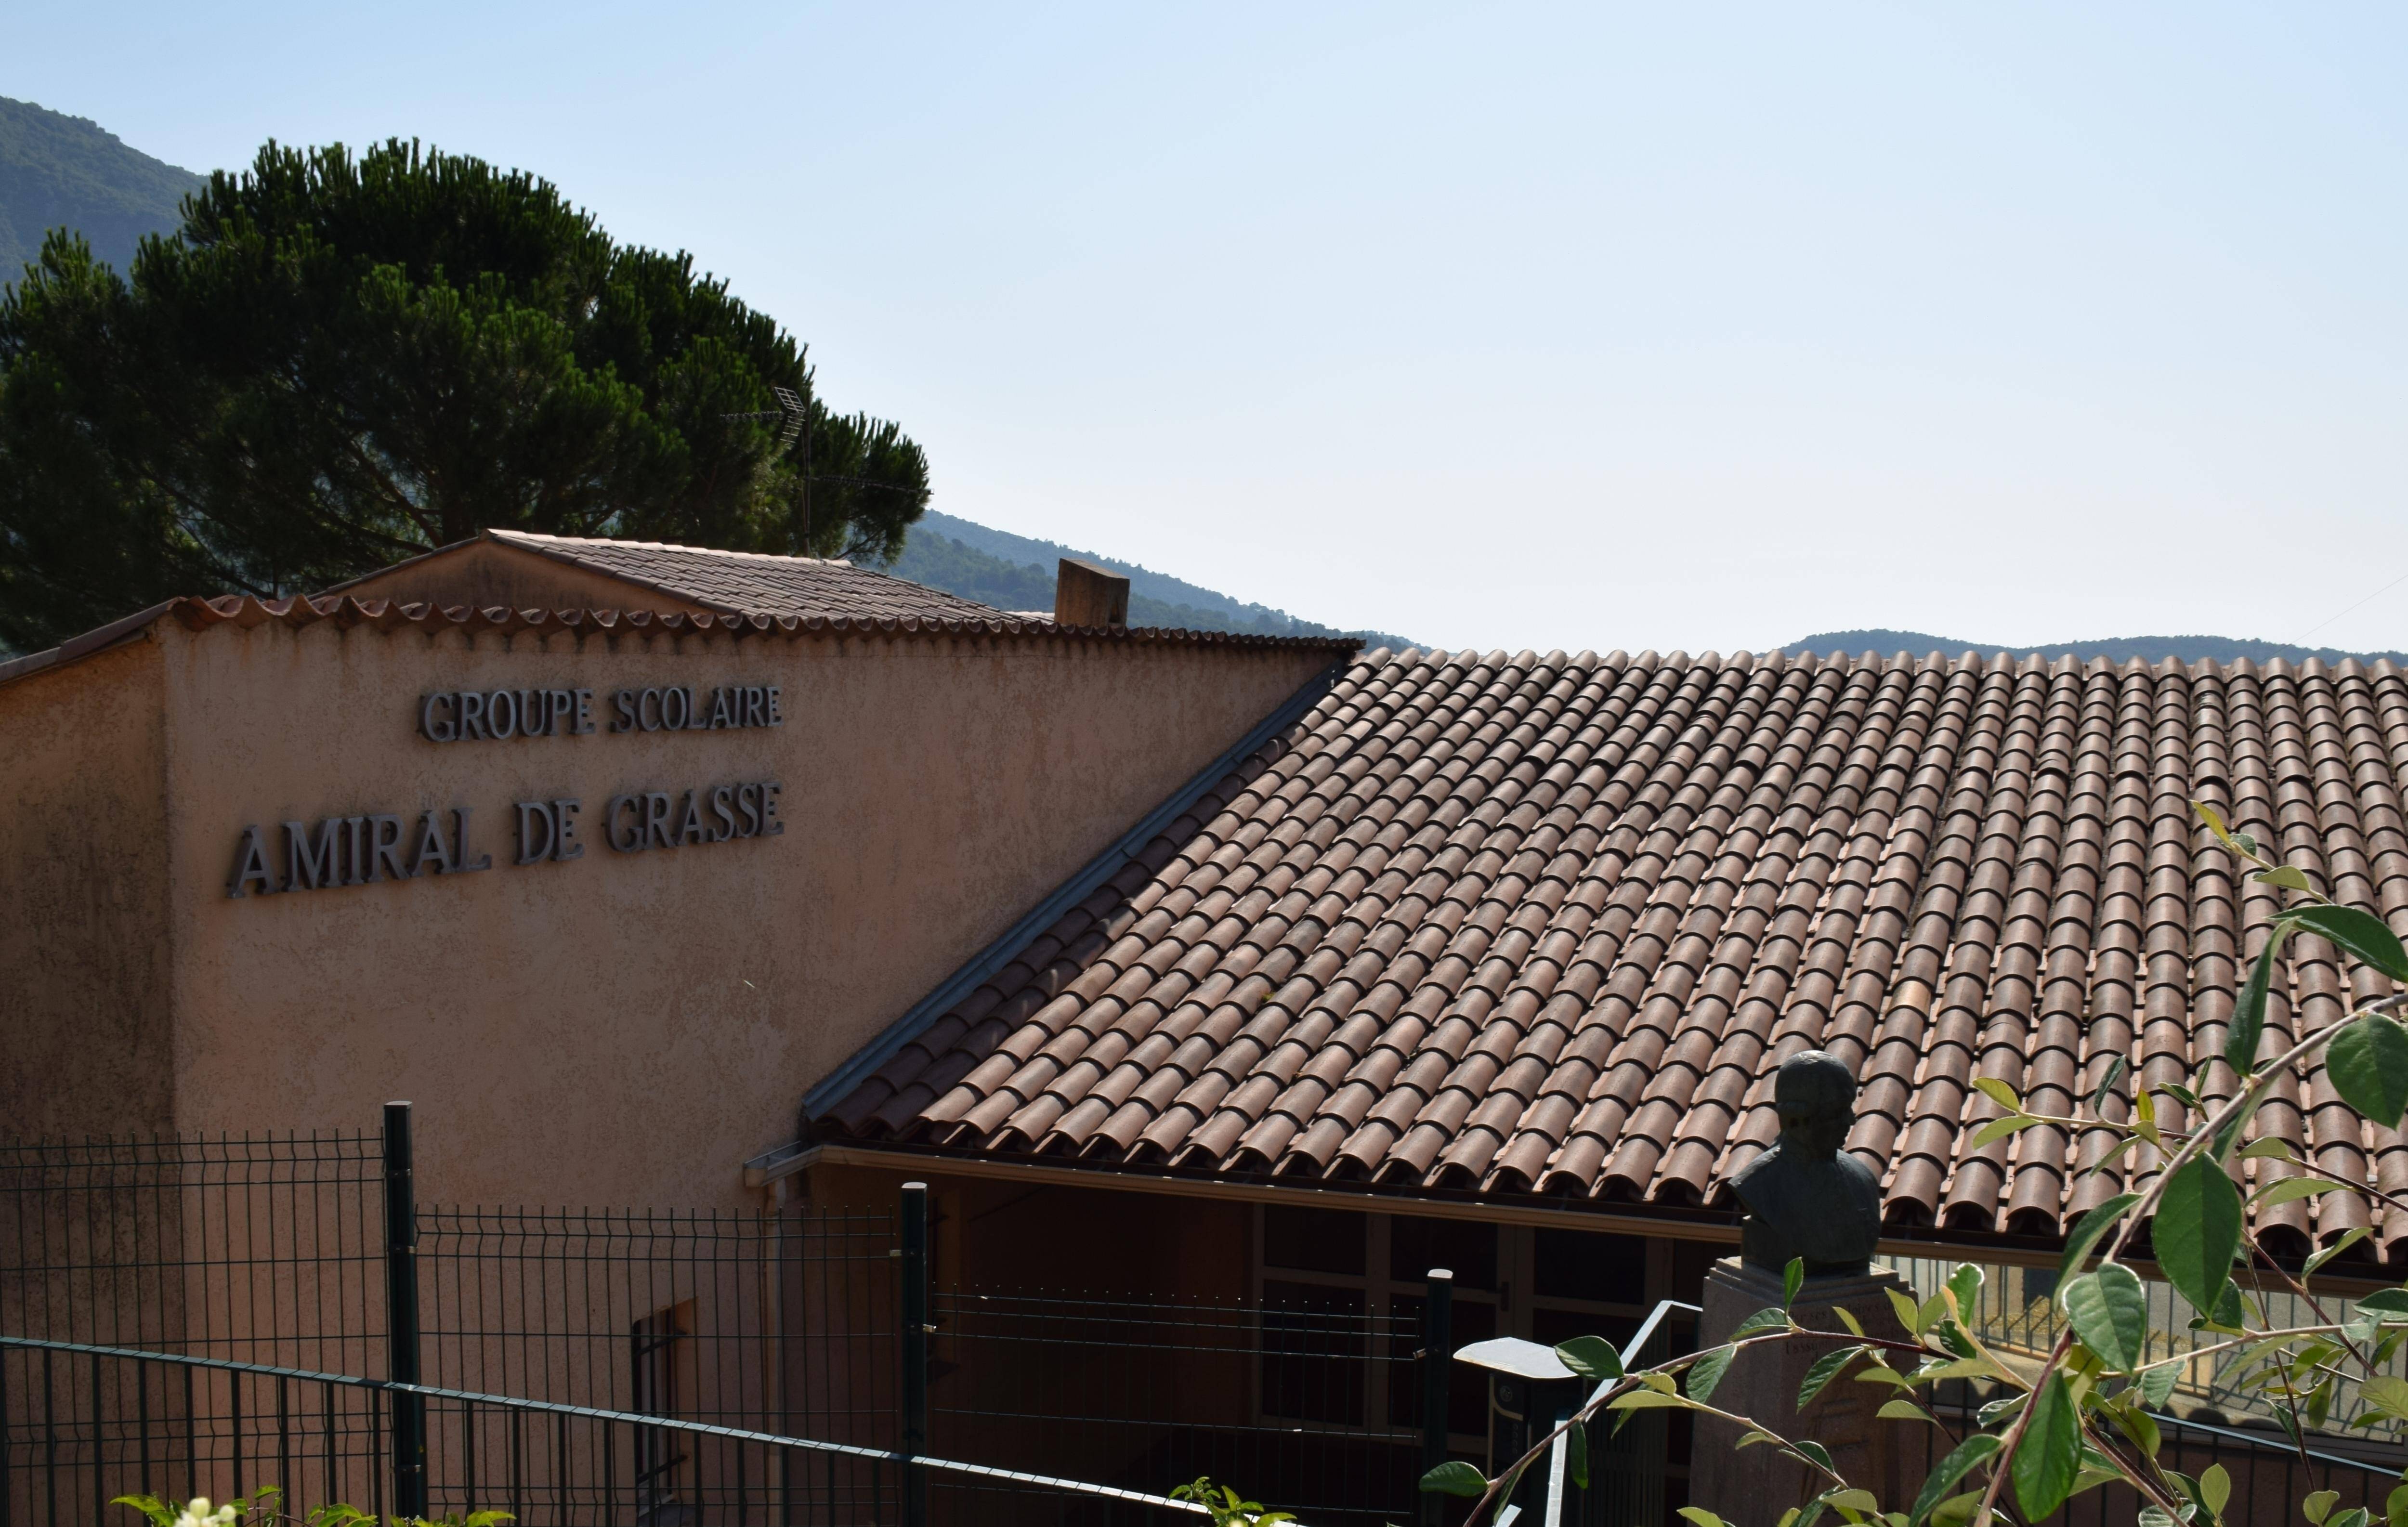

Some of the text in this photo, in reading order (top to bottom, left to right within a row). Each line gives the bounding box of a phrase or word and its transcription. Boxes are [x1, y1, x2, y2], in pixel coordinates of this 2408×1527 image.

[419, 686, 782, 742] GROUPE SCOLAIRE
[226, 782, 784, 899] AMIRAL DE GRASSE
